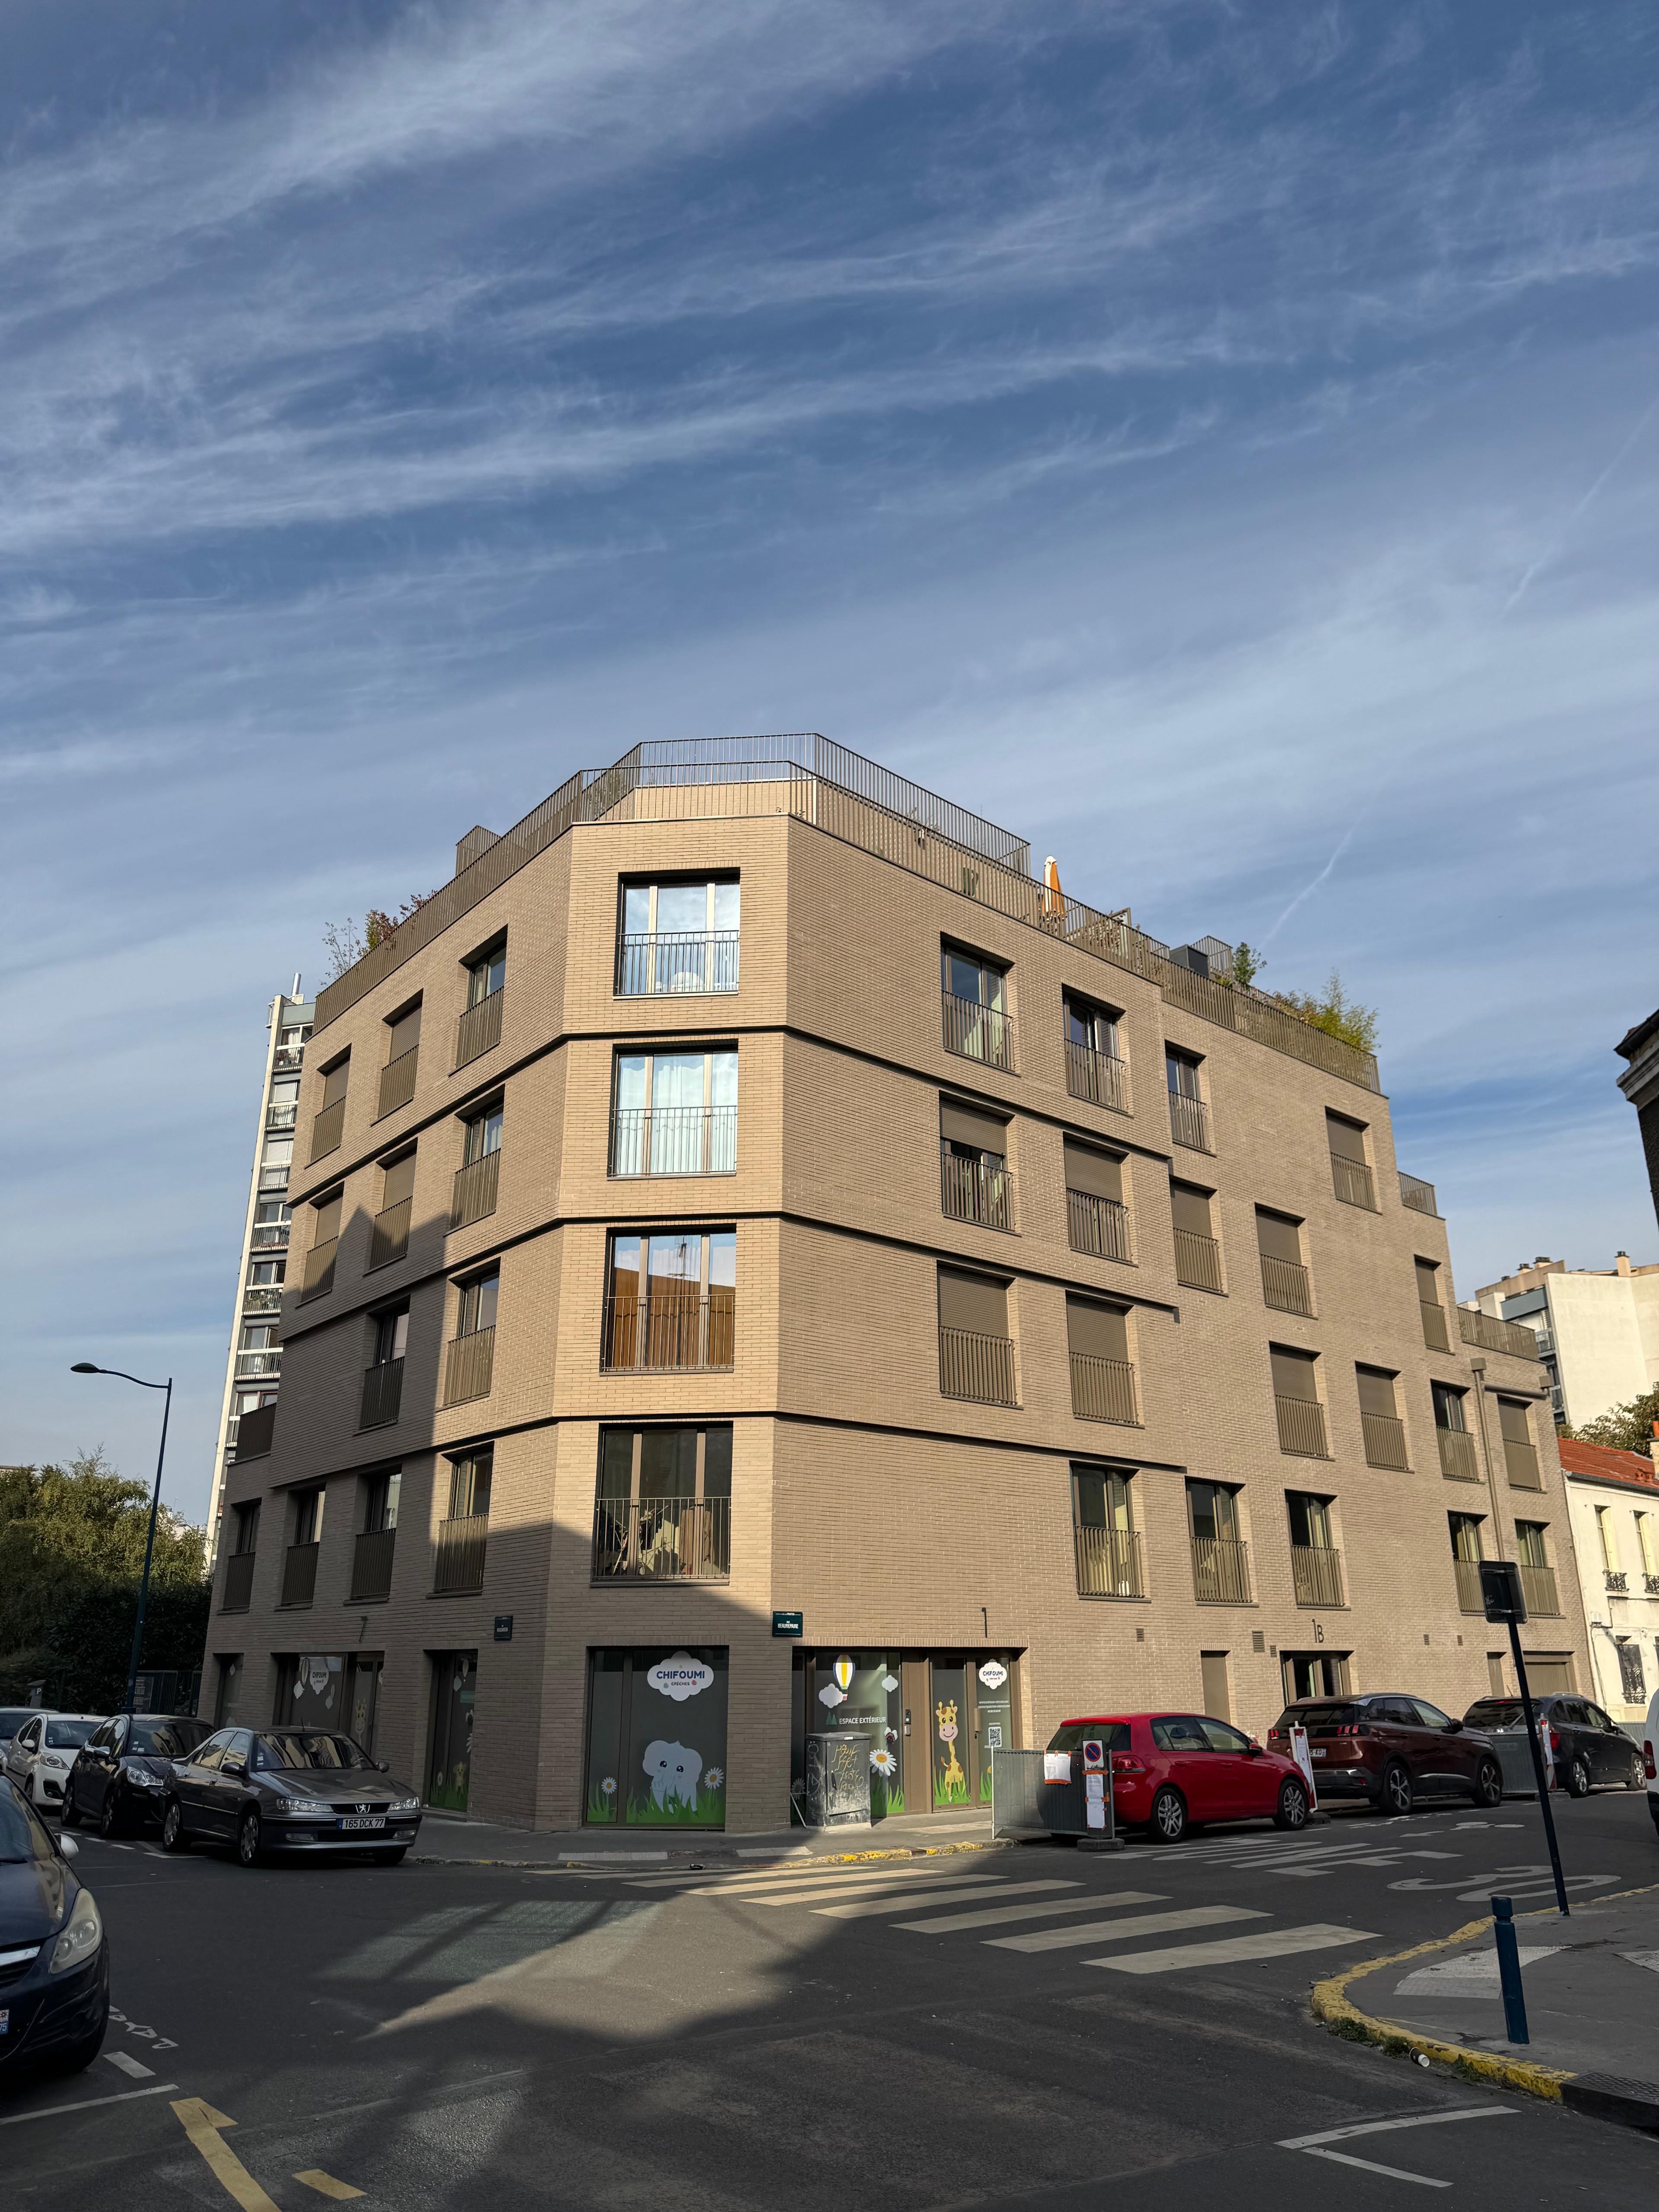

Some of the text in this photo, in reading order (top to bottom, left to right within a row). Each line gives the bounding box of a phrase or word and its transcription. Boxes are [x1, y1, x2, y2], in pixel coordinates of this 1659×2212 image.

[1312, 1619, 1324, 1643] 1B
[656, 1670, 705, 1679] CHIFOUMI
[345, 1818, 384, 1828] 165 DCK 77
[1093, 1838, 1464, 1877] ZONE
[1386, 1865, 1621, 1902] 30
